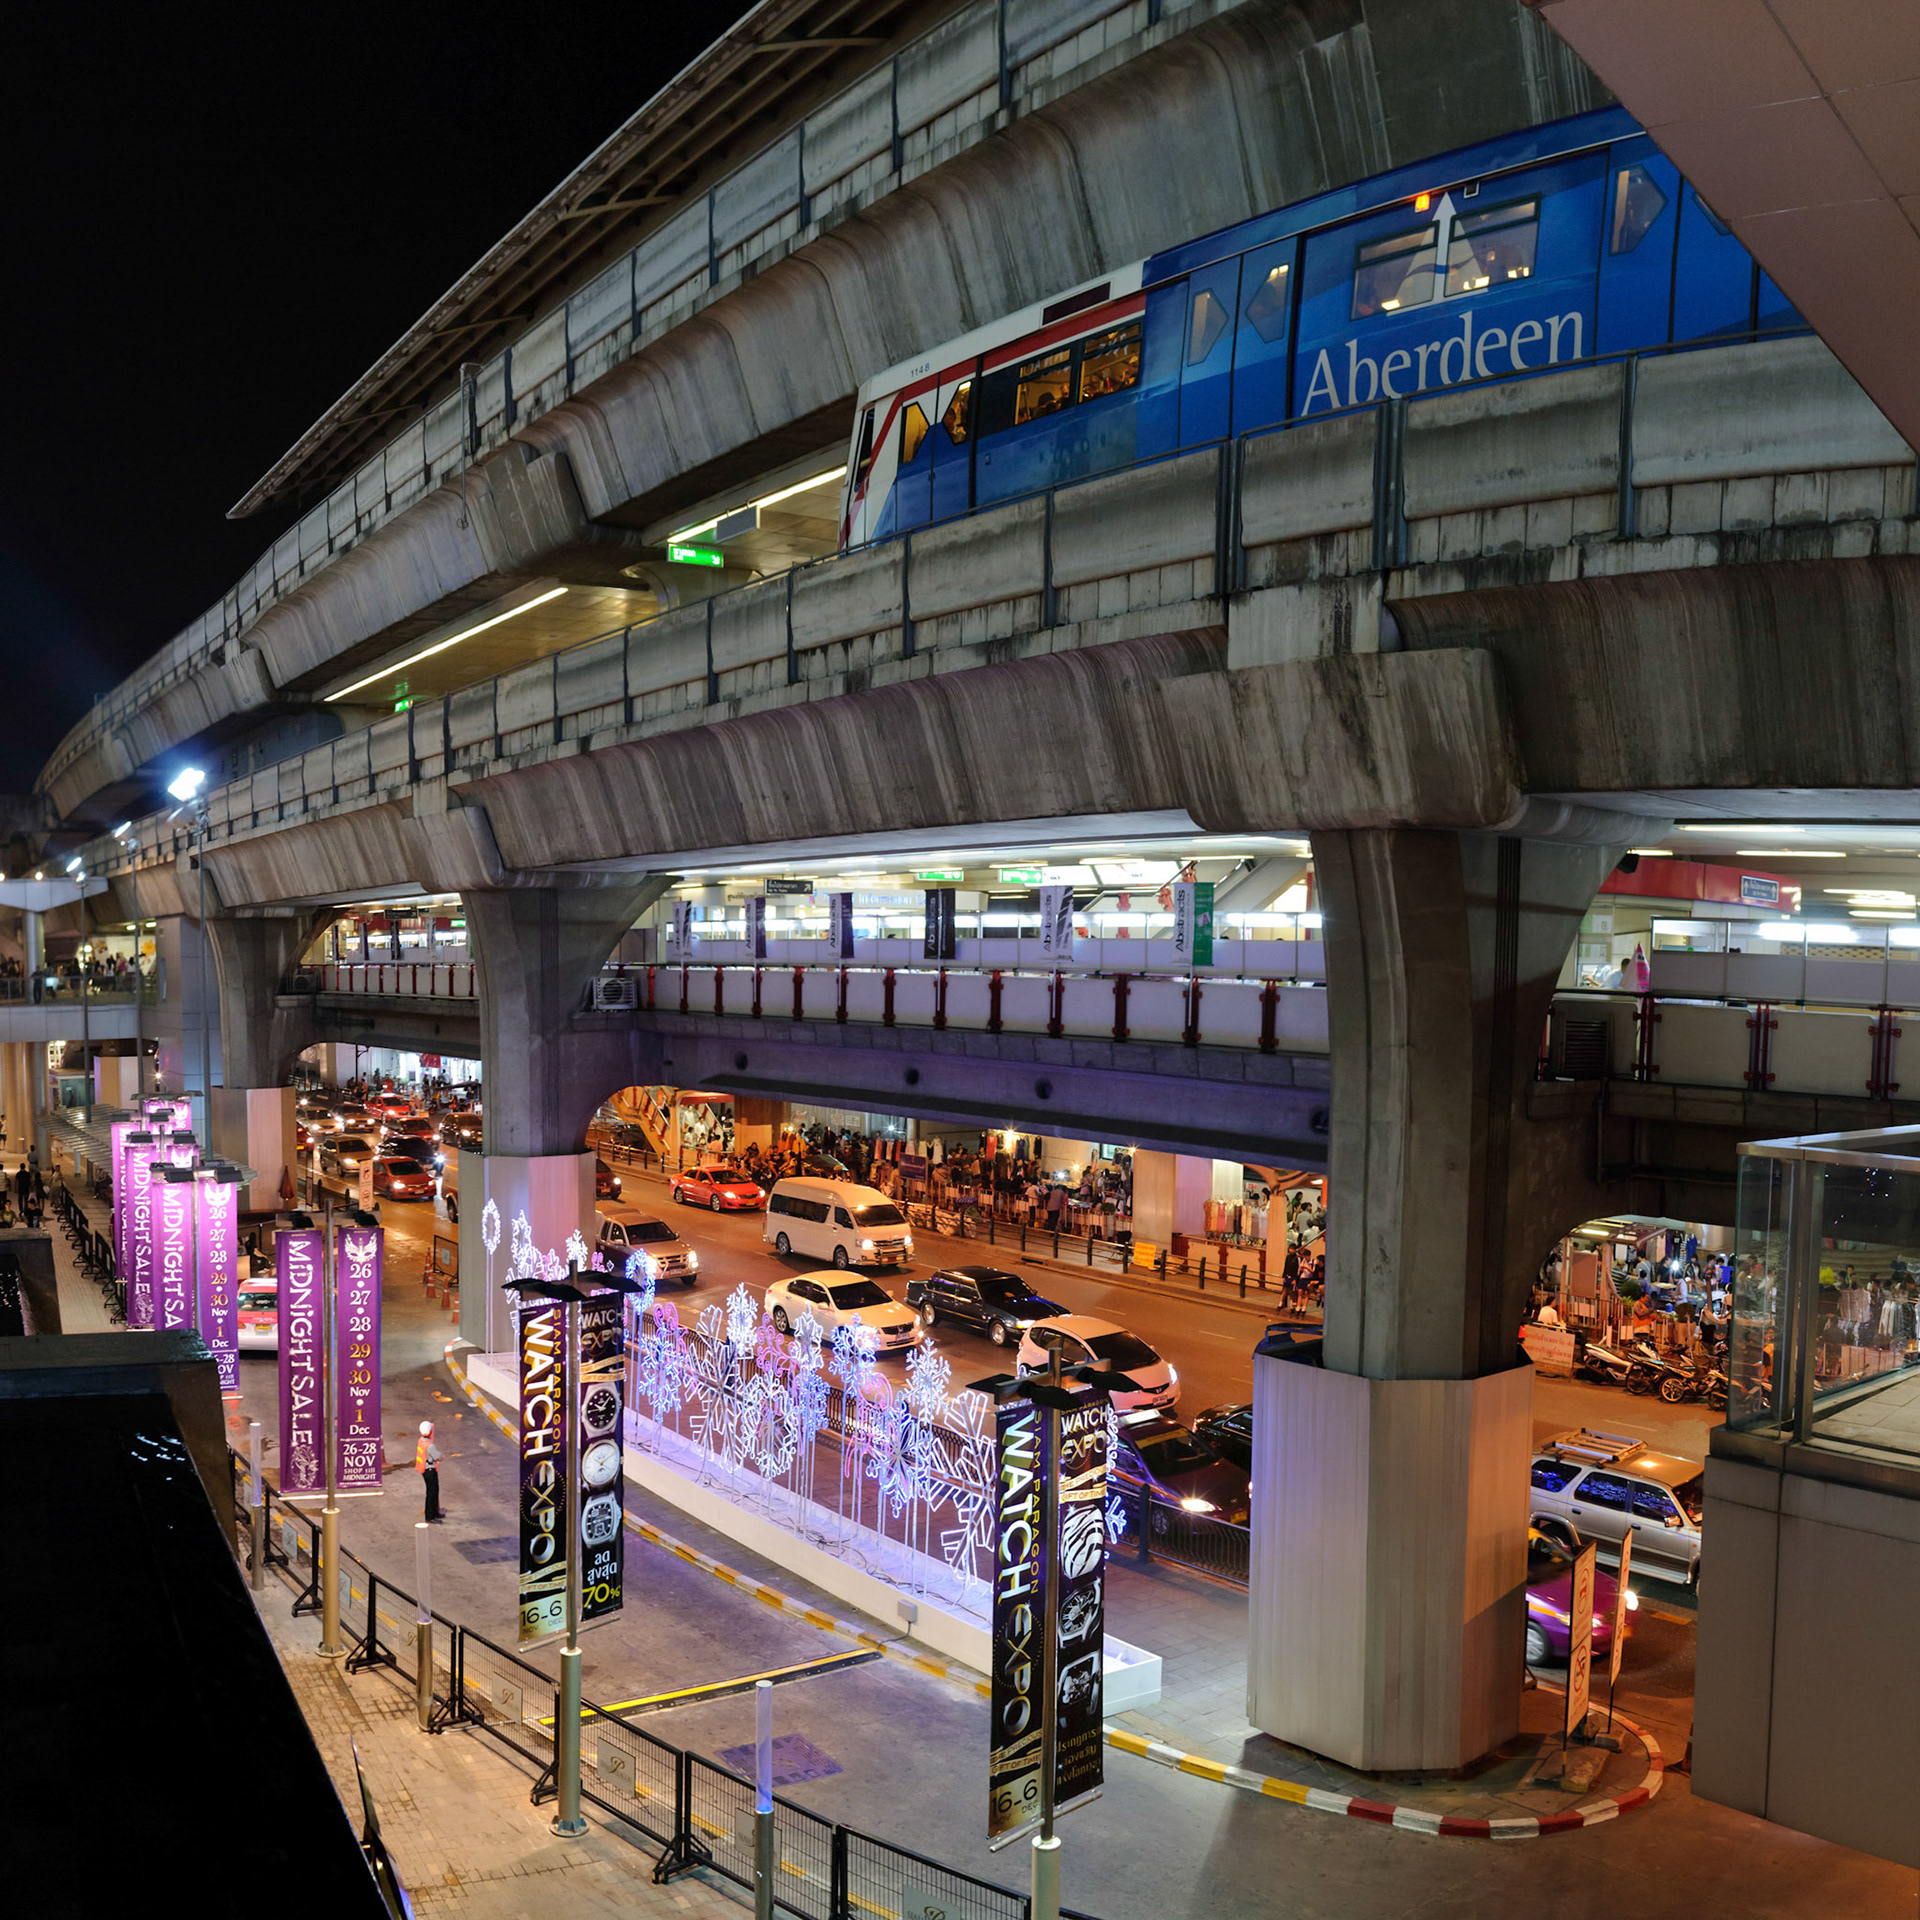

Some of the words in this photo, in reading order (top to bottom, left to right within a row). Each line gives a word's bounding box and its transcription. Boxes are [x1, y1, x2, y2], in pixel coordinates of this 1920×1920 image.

[910, 362, 930, 378] 1148
[1301, 311, 1584, 416] Aberdeen
[860, 892, 912, 904] Information
[927, 897, 936, 952] Abstracts
[1044, 894, 1052, 952] Abstracts
[1175, 890, 1186, 952] Abstracts
[209, 1207, 227, 1220] 26
[210, 1229, 226, 1241] 27
[210, 1250, 228, 1263] 28
[210, 1272, 228, 1285] 29
[350, 1264, 372, 1278] 26
[210, 1294, 228, 1306] 30
[350, 1290, 372, 1305] 27
[212, 1308, 228, 1316] Nov
[580, 1308, 622, 1328] WATCH
[350, 1316, 372, 1332] 28
[216, 1327, 224, 1338] 1
[553, 1309, 562, 1355] SIAM
[212, 1340, 229, 1348] Dec
[350, 1344, 371, 1358] 29
[217, 1364, 234, 1374] OV
[348, 1369, 372, 1384] 30
[525, 1308, 554, 1458] WATCH
[350, 1387, 370, 1396] Nov
[291, 1375, 315, 1446] SALE
[354, 1409, 364, 1422] 1
[553, 1363, 562, 1454] PARAGON
[1061, 1406, 1108, 1434] WATCH
[349, 1425, 370, 1435] Dec
[1034, 1410, 1042, 1468] SIAM
[343, 1443, 377, 1455] 26-28
[1061, 1430, 1106, 1464] EXPO
[344, 1456, 376, 1468] NOV
[1062, 1492, 1078, 1500] GIFT
[530, 1460, 556, 1565] EXPO
[1000, 1409, 1036, 1601] WATCH
[1030, 1478, 1041, 1594] PARAGON
[594, 1550, 610, 1565] ลด
[587, 1562, 618, 1585] สูงสุด
[520, 1584, 537, 1592] GIFT
[548, 1580, 565, 1589] TIME
[522, 1626, 539, 1634] NOV
[548, 1617, 564, 1626] DEC
[1003, 1603, 1032, 1736] EXPO
[1007, 1731, 1042, 1756] PRECIOUS
[992, 1762, 1010, 1774] GIFT
[1010, 1760, 1022, 1769] OF
[1024, 1754, 1040, 1766] TIME
[1022, 1800, 1038, 1813] DEC
